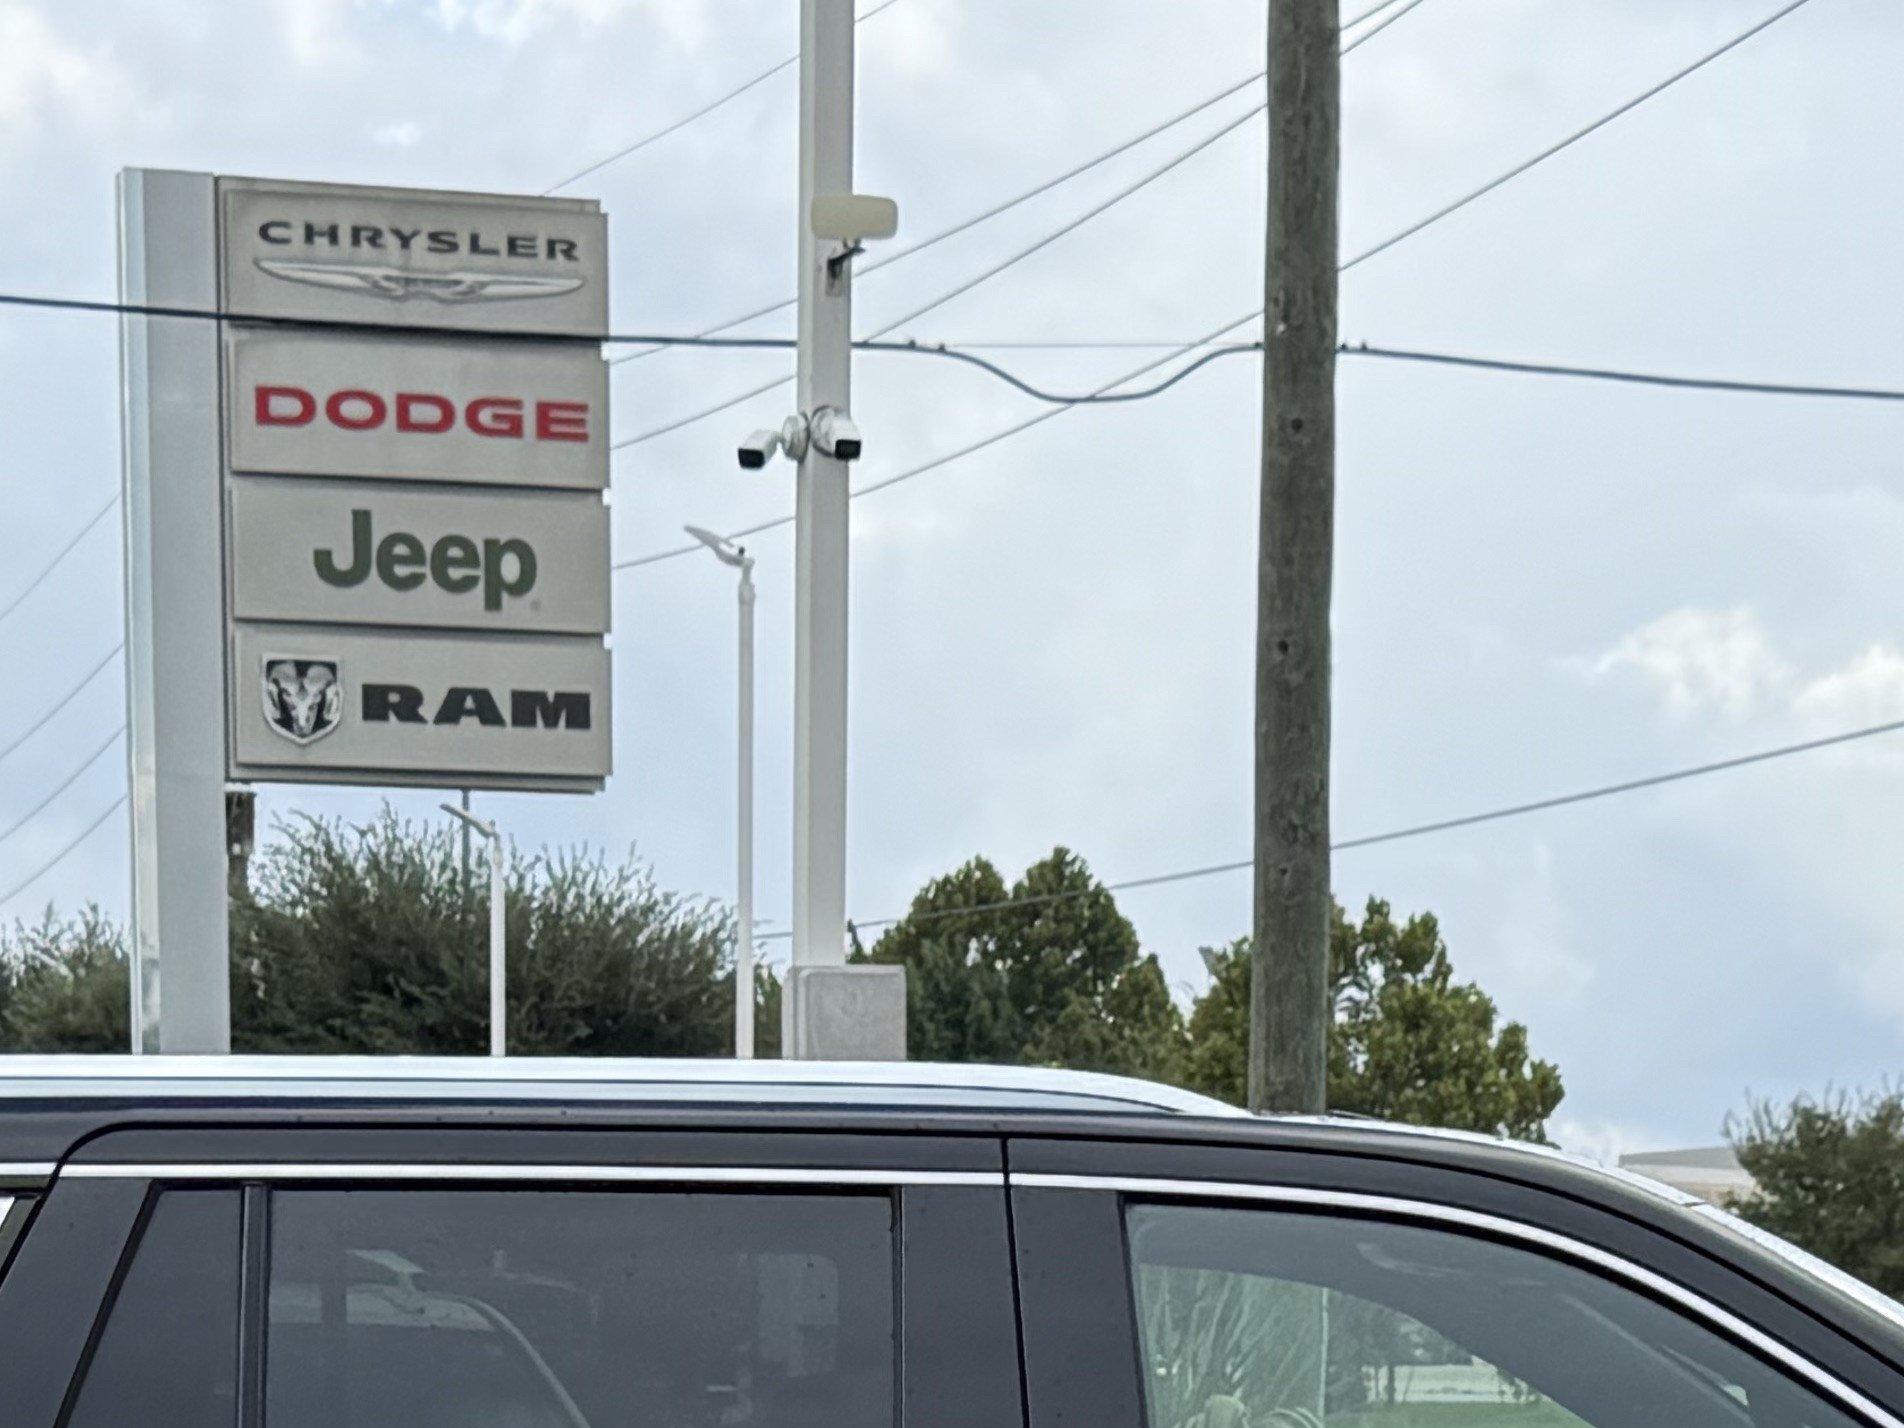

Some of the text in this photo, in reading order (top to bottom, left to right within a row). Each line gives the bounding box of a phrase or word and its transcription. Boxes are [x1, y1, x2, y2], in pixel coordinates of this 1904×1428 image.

[257, 219, 580, 262] CHRYSLER
[254, 386, 590, 443] DODGE
[313, 509, 538, 612] Jeep
[361, 683, 593, 731] RAM
